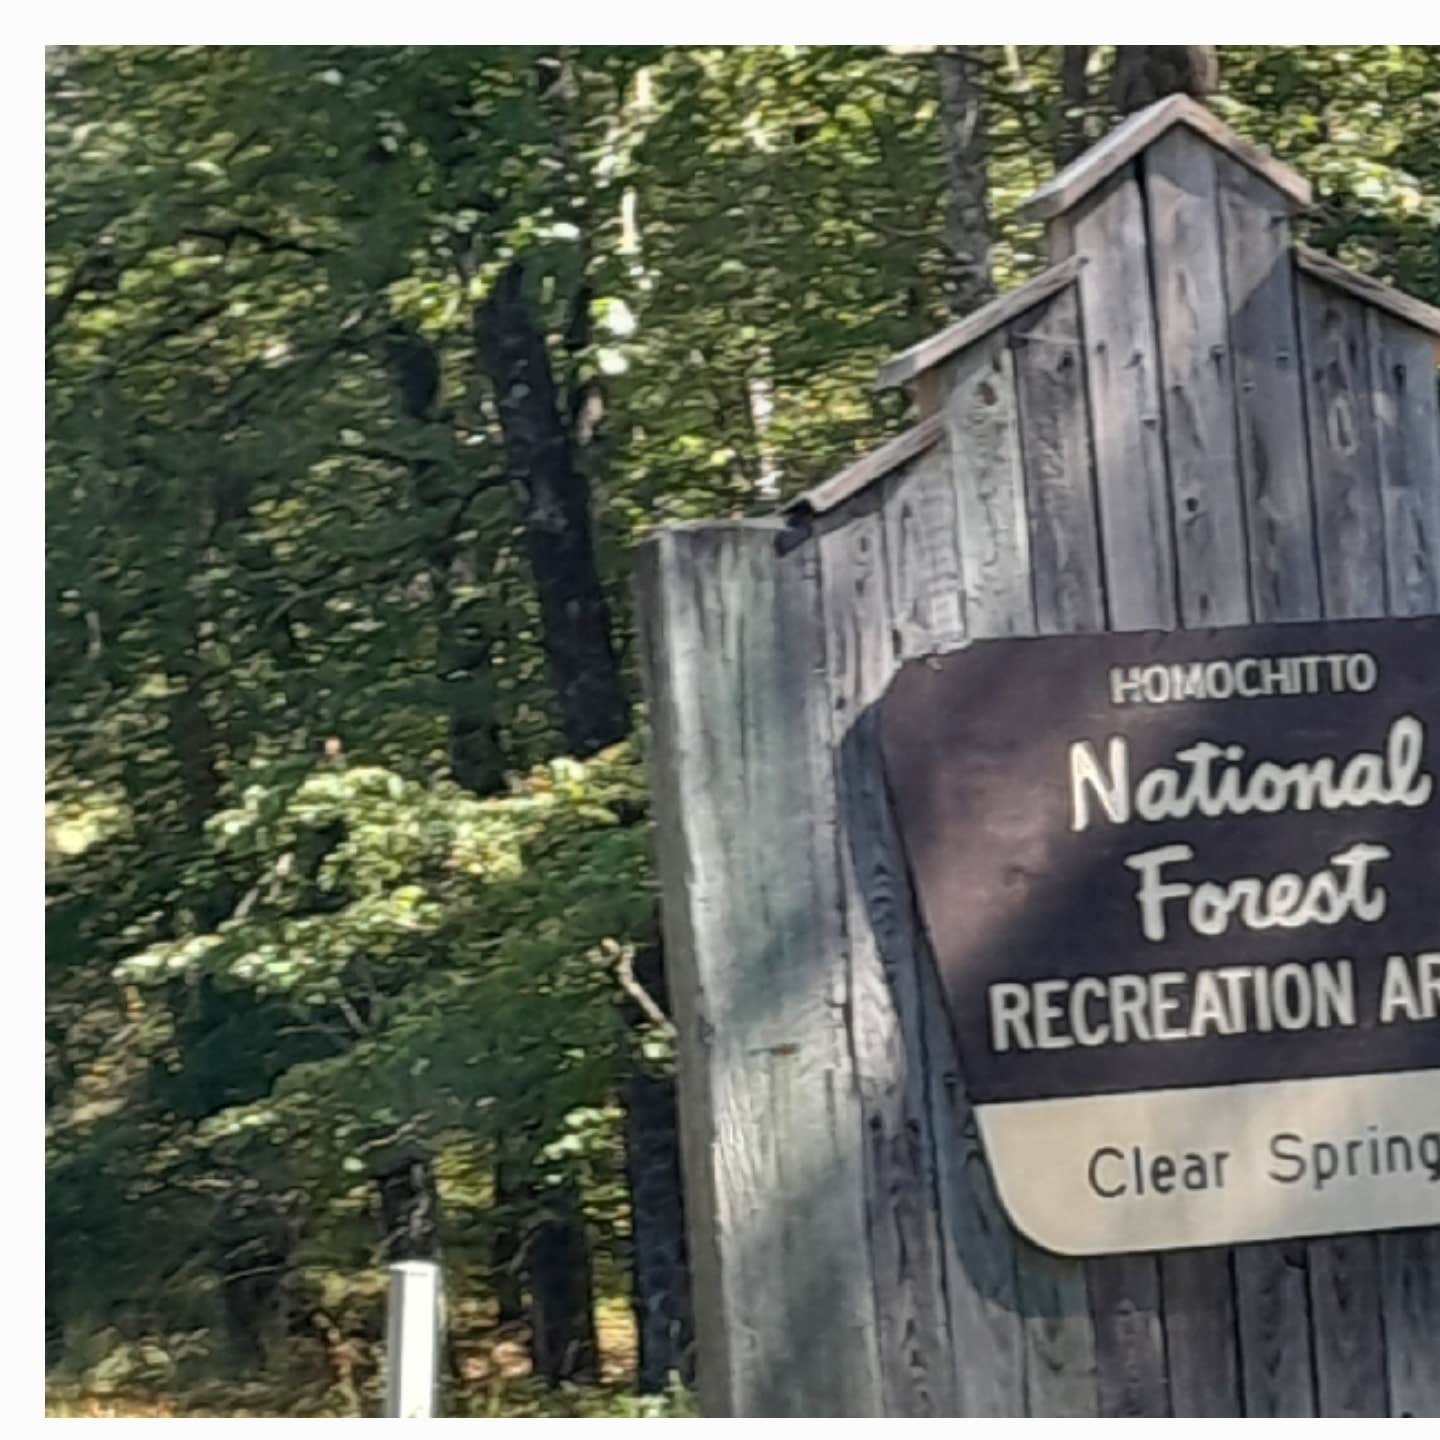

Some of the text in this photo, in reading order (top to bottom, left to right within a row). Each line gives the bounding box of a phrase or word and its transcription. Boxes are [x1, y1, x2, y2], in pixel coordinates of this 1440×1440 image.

[1110, 652, 1378, 704] HOMOCHITTO
[1069, 715, 1432, 831] National
[1125, 843, 1390, 941] Forest
[989, 959, 1356, 1051] RECREATION
[1088, 1146, 1231, 1198] Clear
